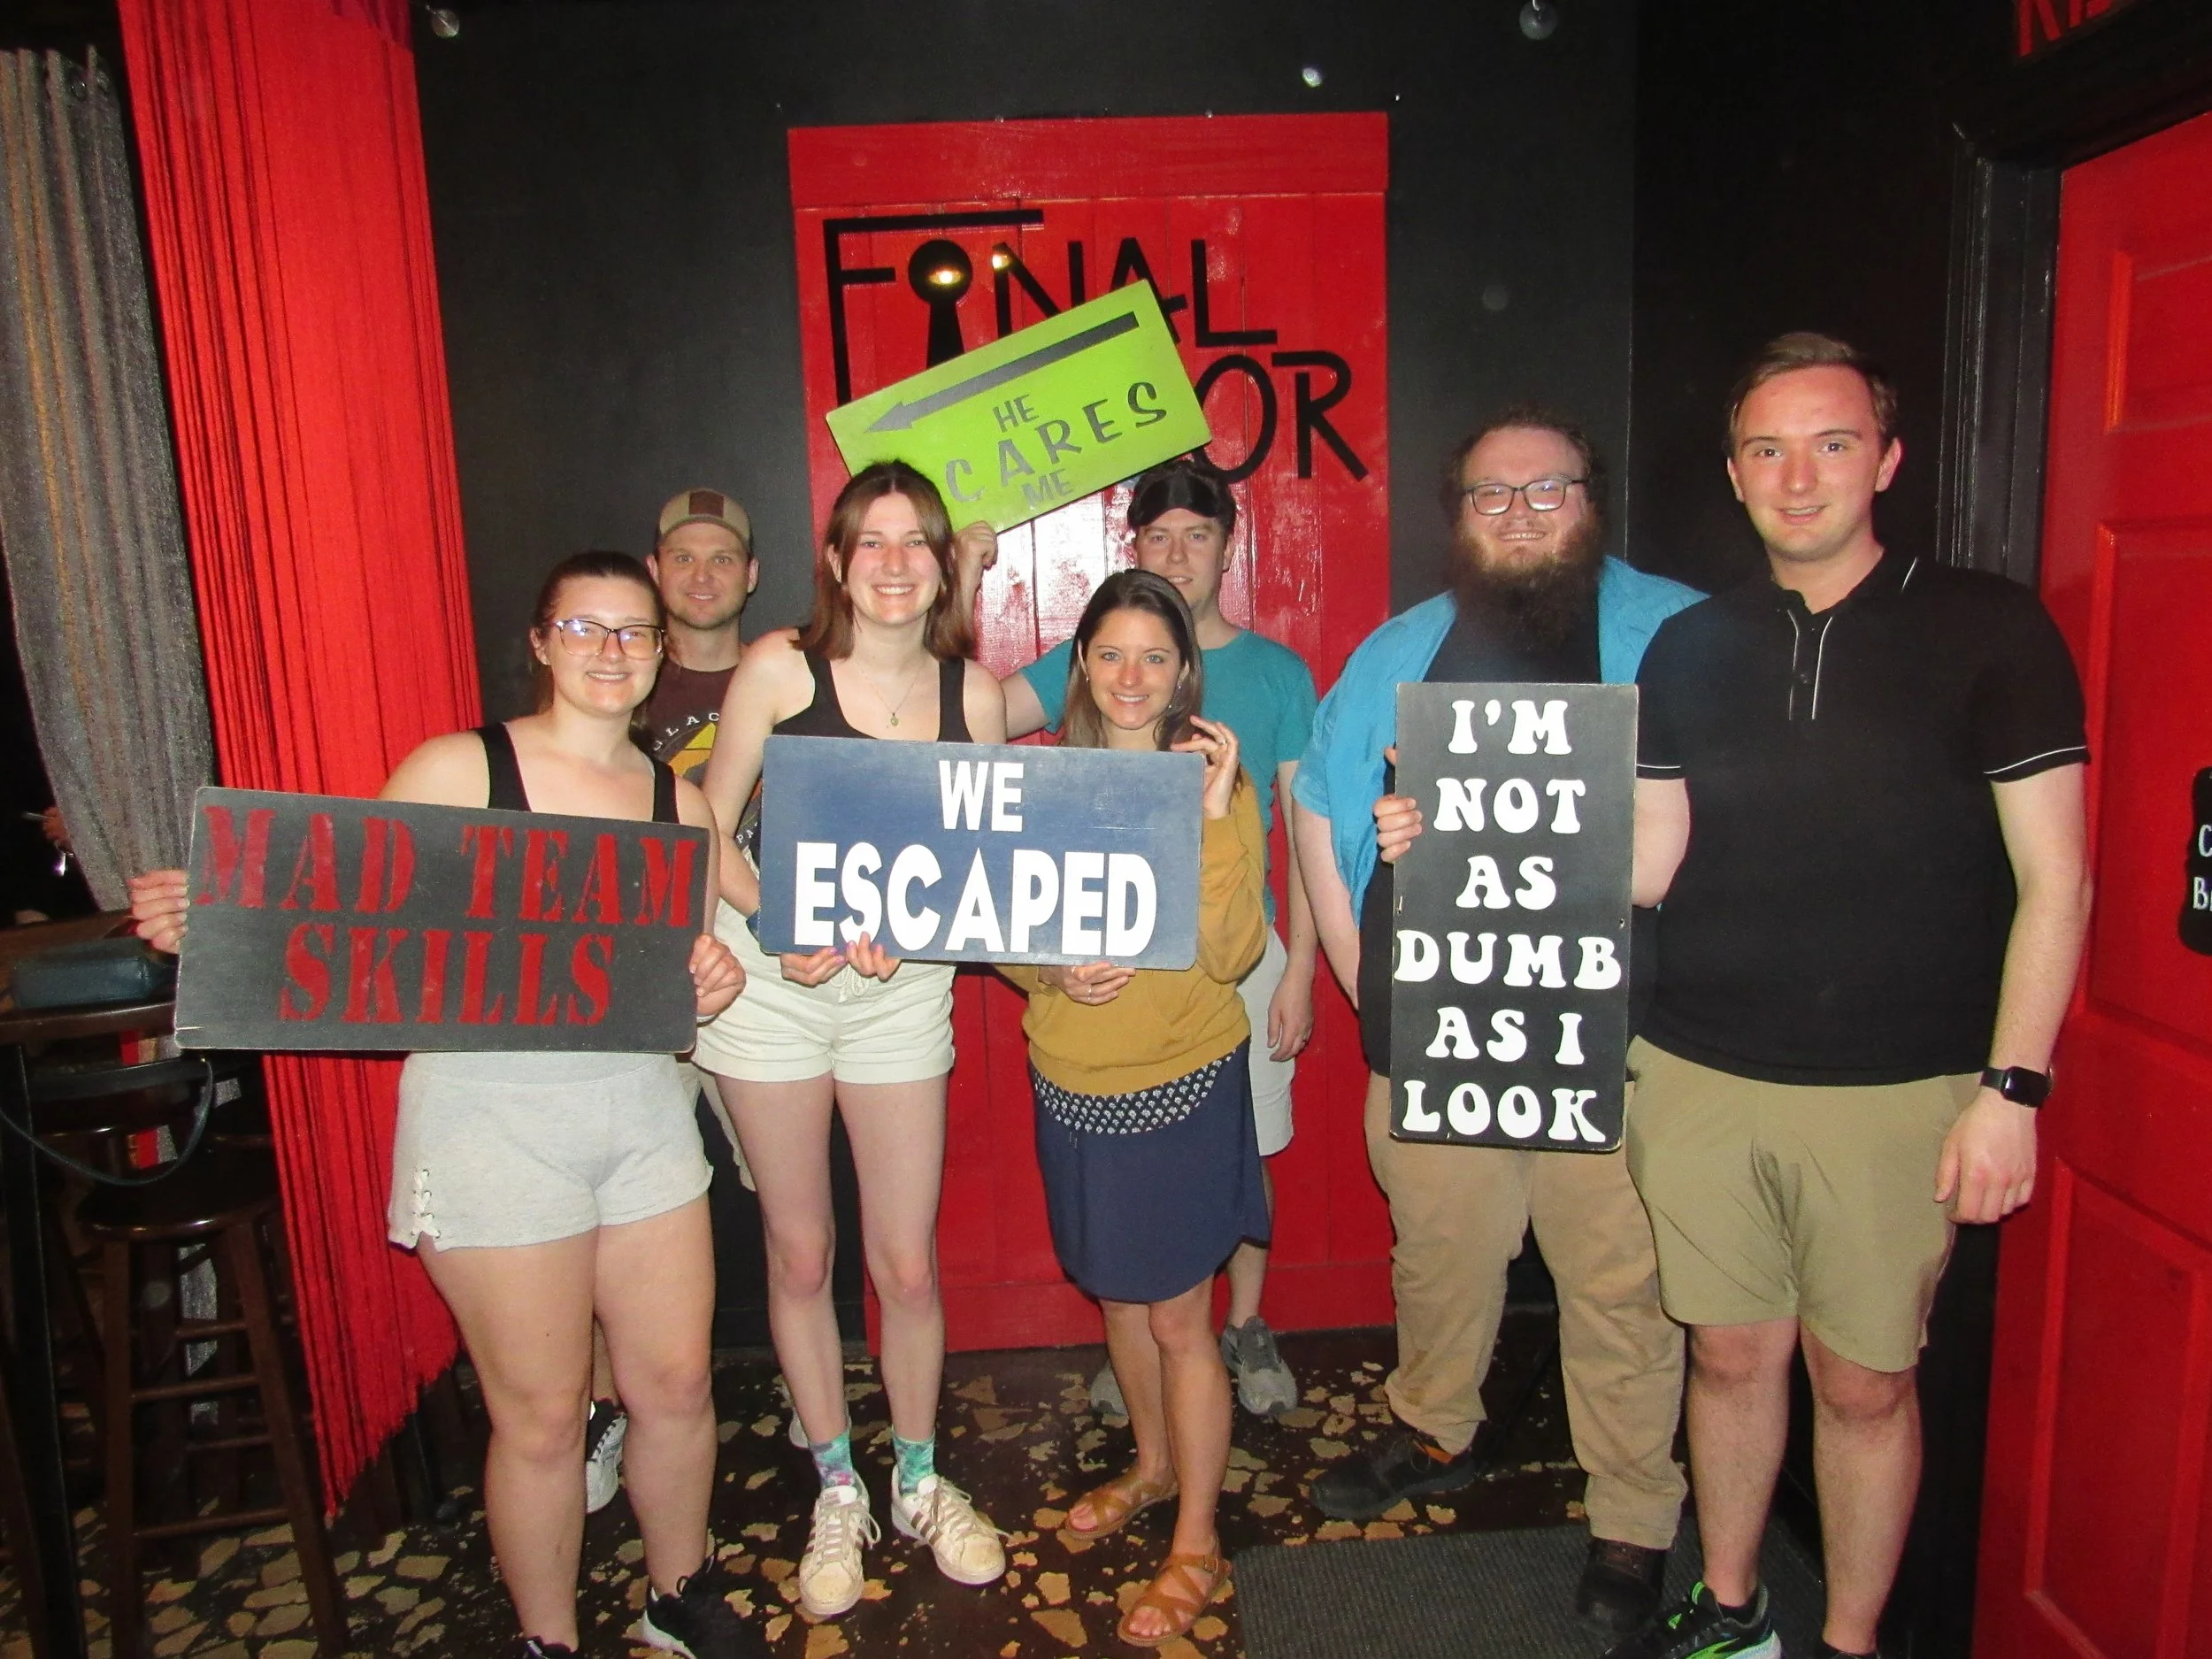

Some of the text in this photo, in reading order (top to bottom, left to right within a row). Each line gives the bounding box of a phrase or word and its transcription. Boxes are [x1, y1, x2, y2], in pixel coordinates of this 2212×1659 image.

[945, 381, 1167, 503] CARES
[992, 394, 1040, 434] HE
[1020, 468, 1074, 508] ME
[1448, 699, 1572, 756] I'M
[939, 760, 1025, 833] WE
[1433, 777, 1586, 834] NOT
[196, 805, 700, 928] MAD TEAM
[1455, 855, 1557, 910] AS
[794, 841, 1158, 957] ESCAPED
[278, 921, 616, 1025] SKILLS
[1394, 929, 1622, 990] DUMB
[1425, 1005, 1586, 1065] AS I
[1402, 1079, 1607, 1143] LOOK
